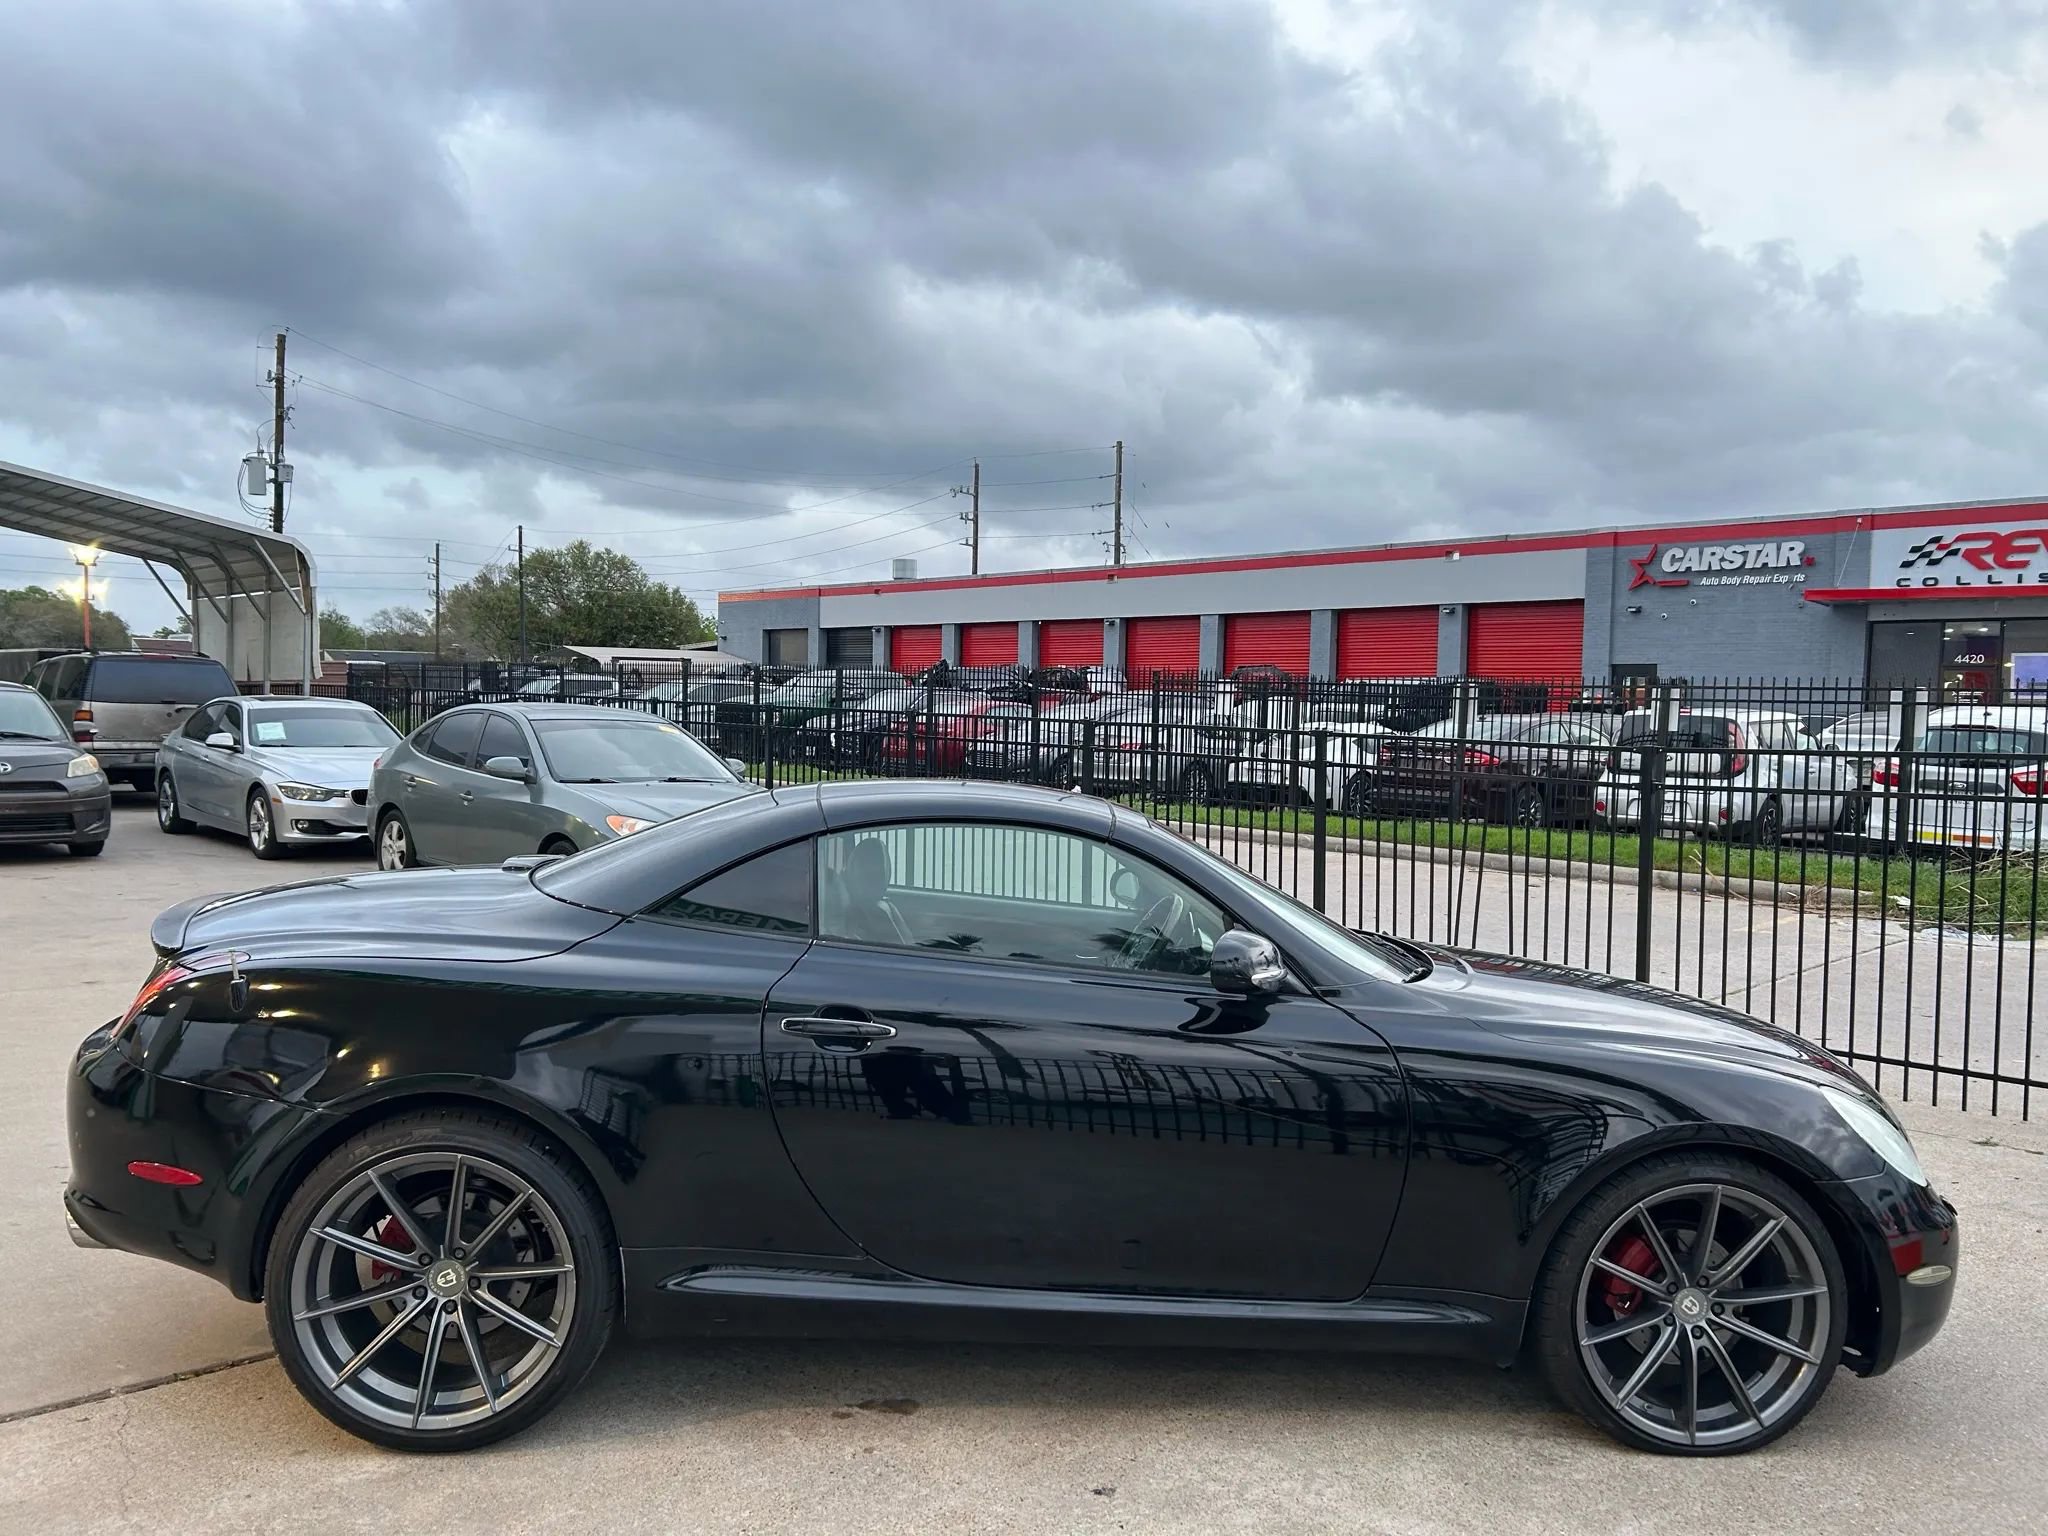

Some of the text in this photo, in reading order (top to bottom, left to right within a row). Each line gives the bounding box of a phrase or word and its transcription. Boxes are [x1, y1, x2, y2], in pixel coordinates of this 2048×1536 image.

[1661, 541, 1805, 573] CARSTAR
[1700, 573, 1806, 587] Auto Body Repair Exprts
[1896, 572, 2048, 588] COLLIS
[1954, 654, 1985, 664] 4420
